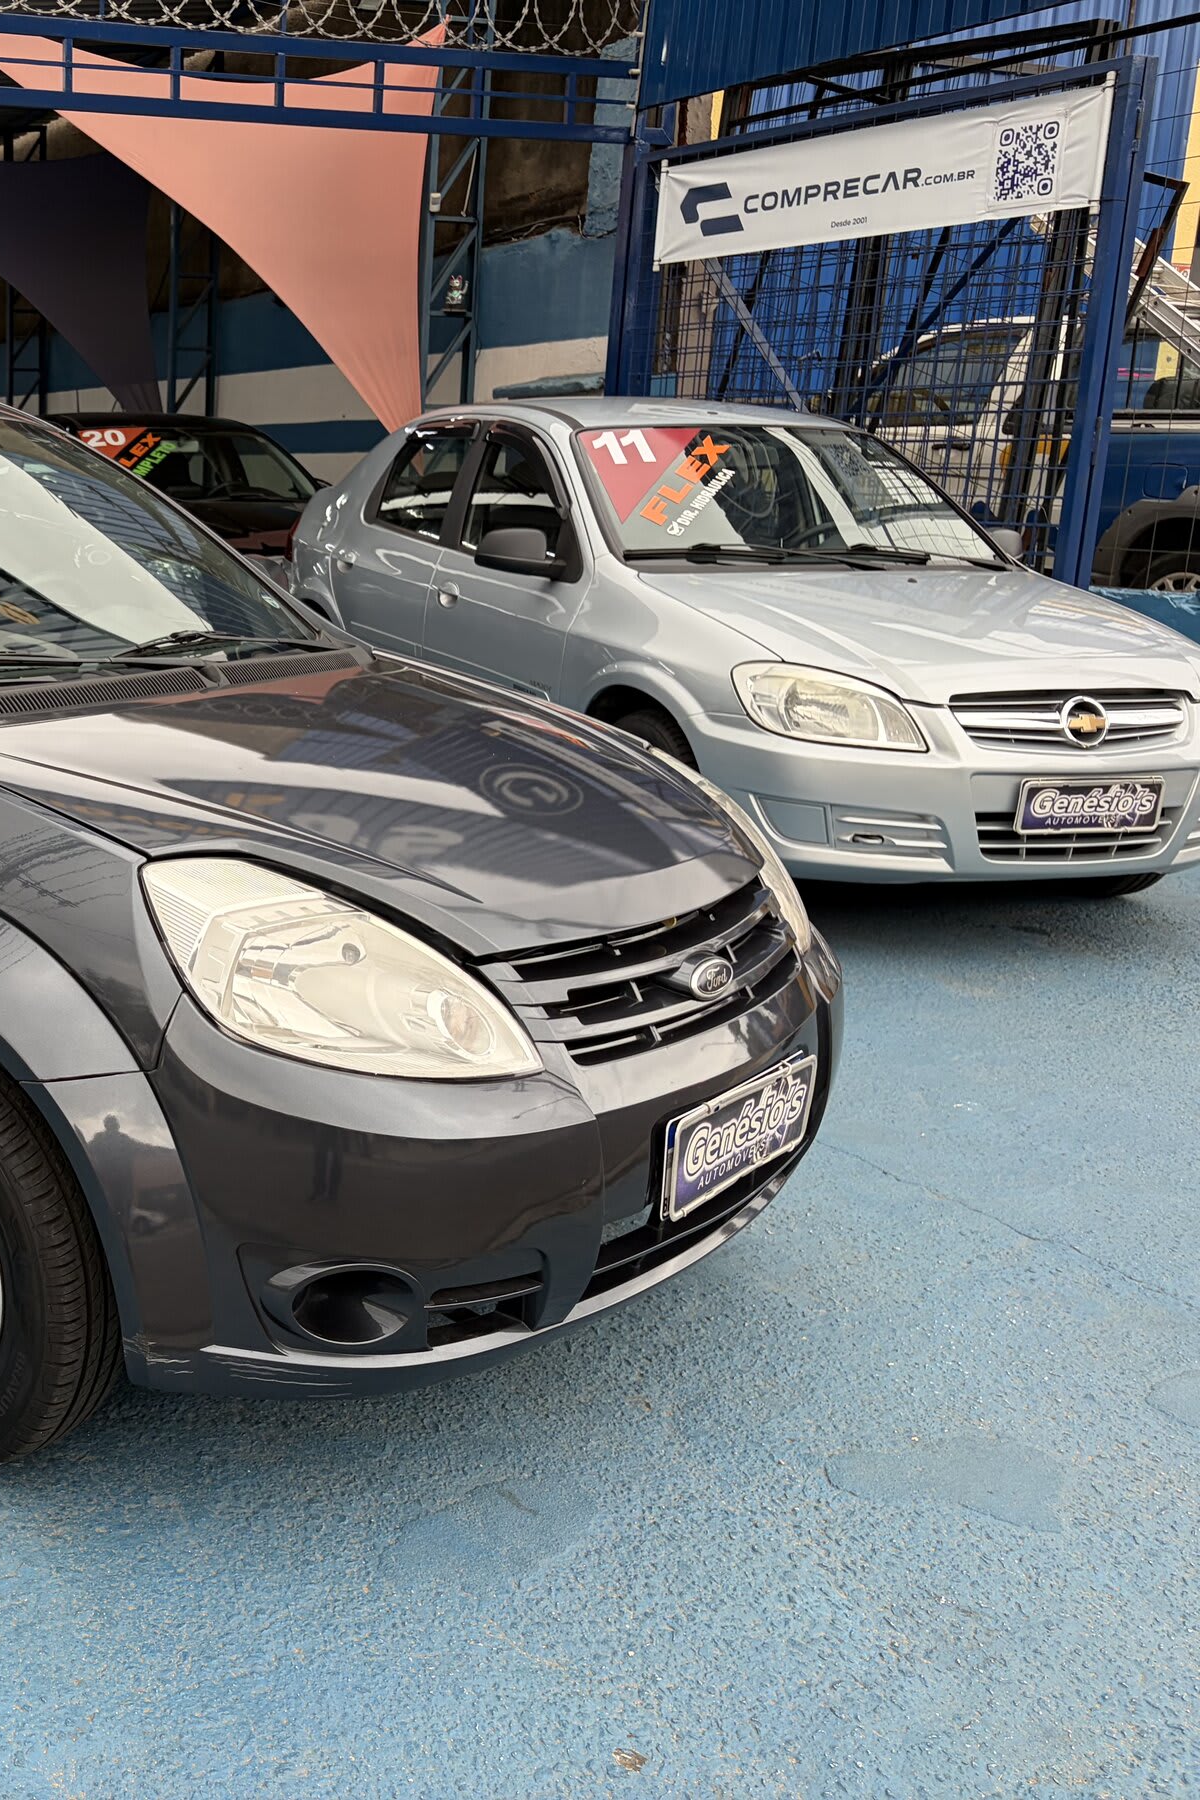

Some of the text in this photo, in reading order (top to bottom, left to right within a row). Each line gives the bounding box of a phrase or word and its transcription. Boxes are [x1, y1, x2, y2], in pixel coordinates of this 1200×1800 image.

[830, 216, 868, 229] Desde 2001
[82, 429, 126, 448] 20
[118, 432, 162, 468] LEX
[592, 429, 657, 465] 11
[131, 442, 177, 478] MPLETO
[639, 435, 732, 526] FLEX
[677, 507, 700, 527] DIR.
[1030, 788, 1157, 818] Genésio's
[705, 966, 728, 991] Ford
[684, 1080, 808, 1182] Genésio's
